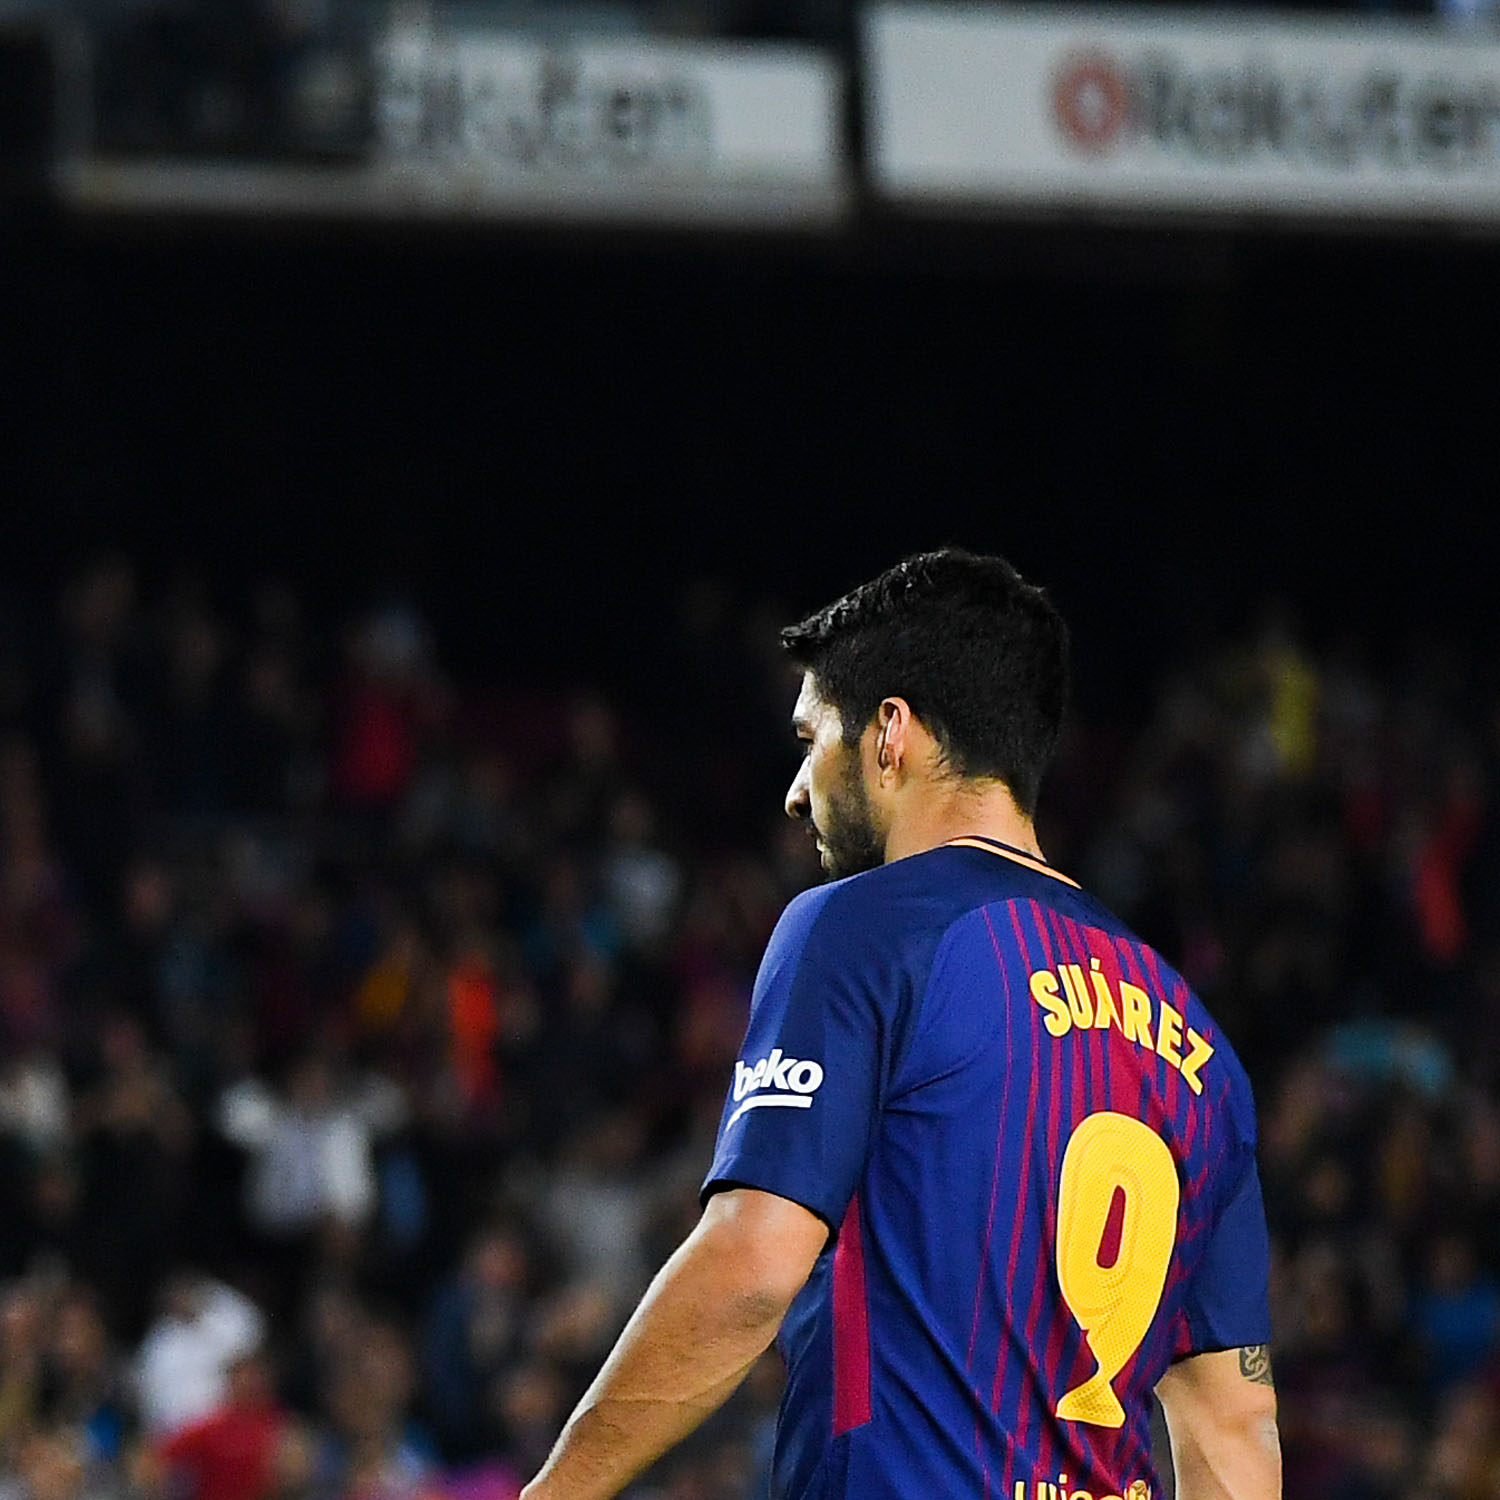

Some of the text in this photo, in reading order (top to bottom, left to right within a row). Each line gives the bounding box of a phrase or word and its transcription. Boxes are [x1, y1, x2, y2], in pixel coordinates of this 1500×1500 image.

[733, 1048, 824, 1102] beko
[1030, 958, 1214, 1096] SUÁREZ
[1056, 1111, 1180, 1429] 9
